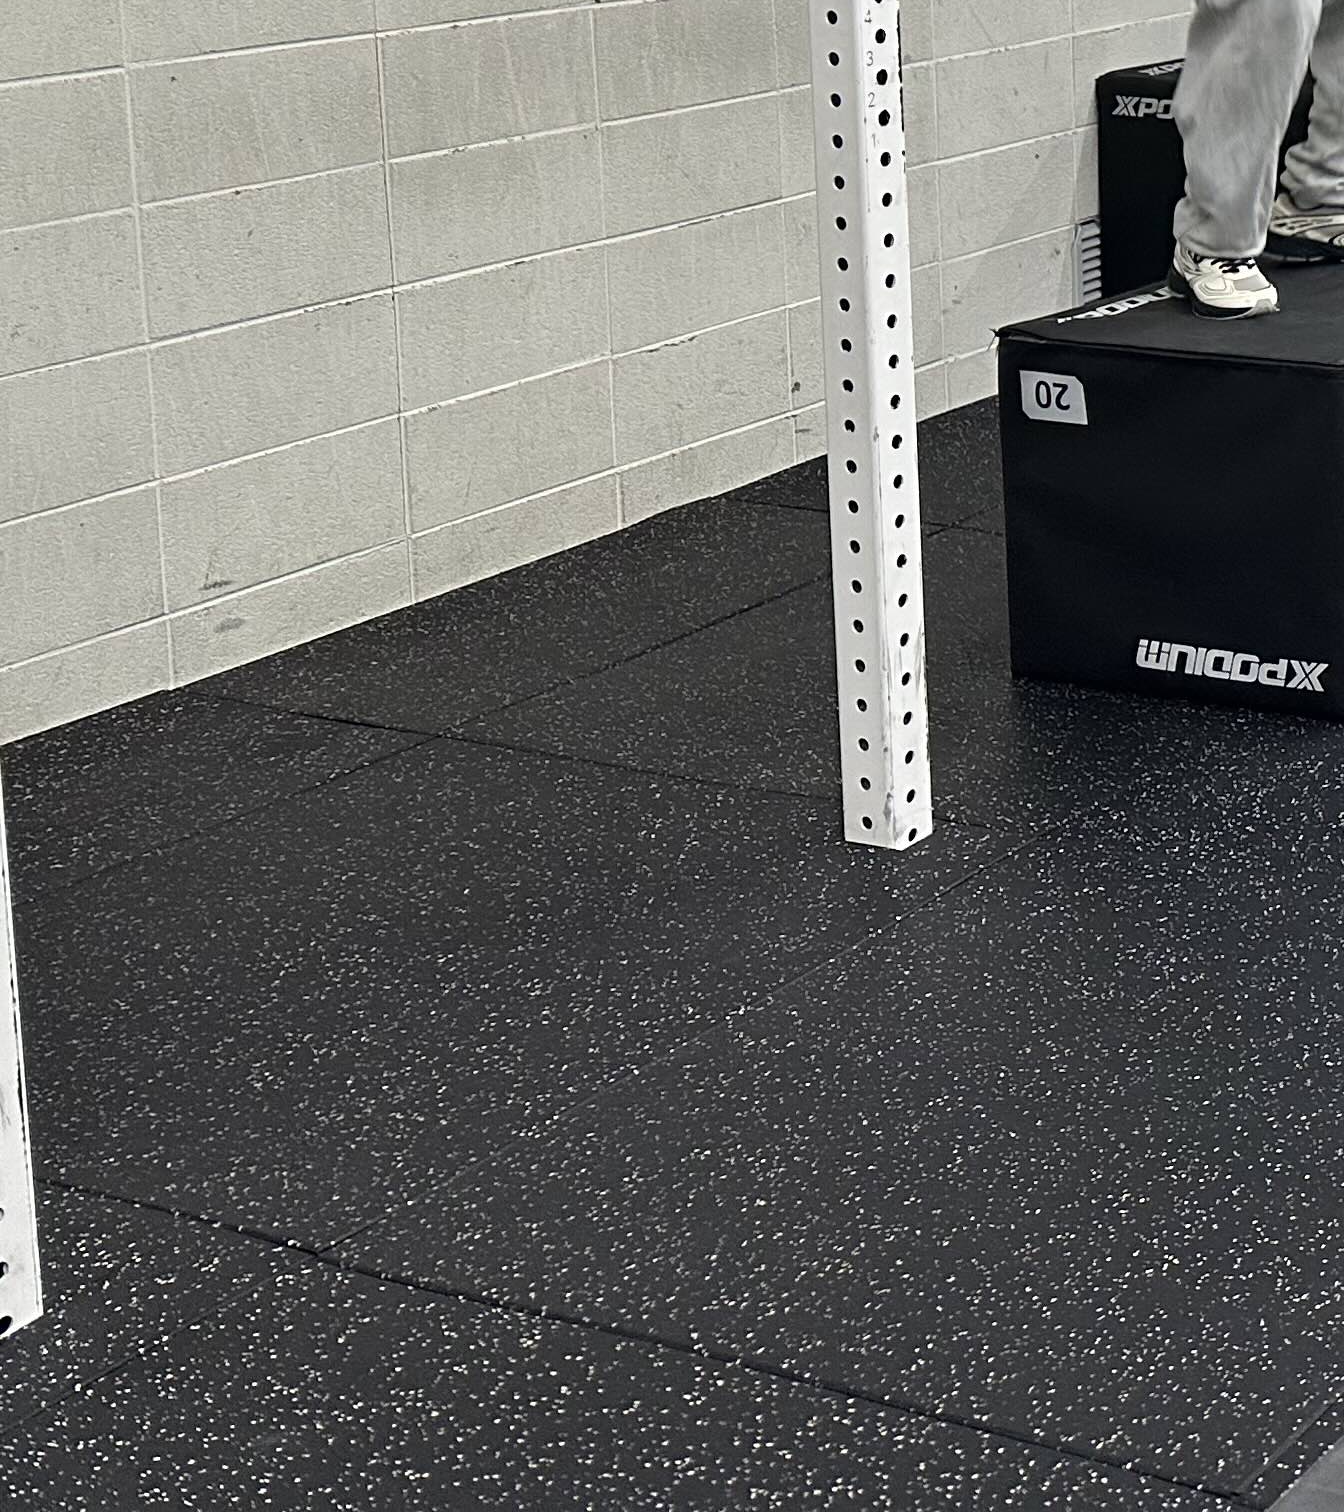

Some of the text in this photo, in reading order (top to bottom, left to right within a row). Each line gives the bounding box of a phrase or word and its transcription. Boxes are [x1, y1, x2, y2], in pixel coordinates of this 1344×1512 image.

[866, 50, 874, 66] 3
[867, 91, 875, 107] 2
[1035, 380, 1071, 411] 20
[1136, 638, 1329, 692] XPODIUM
